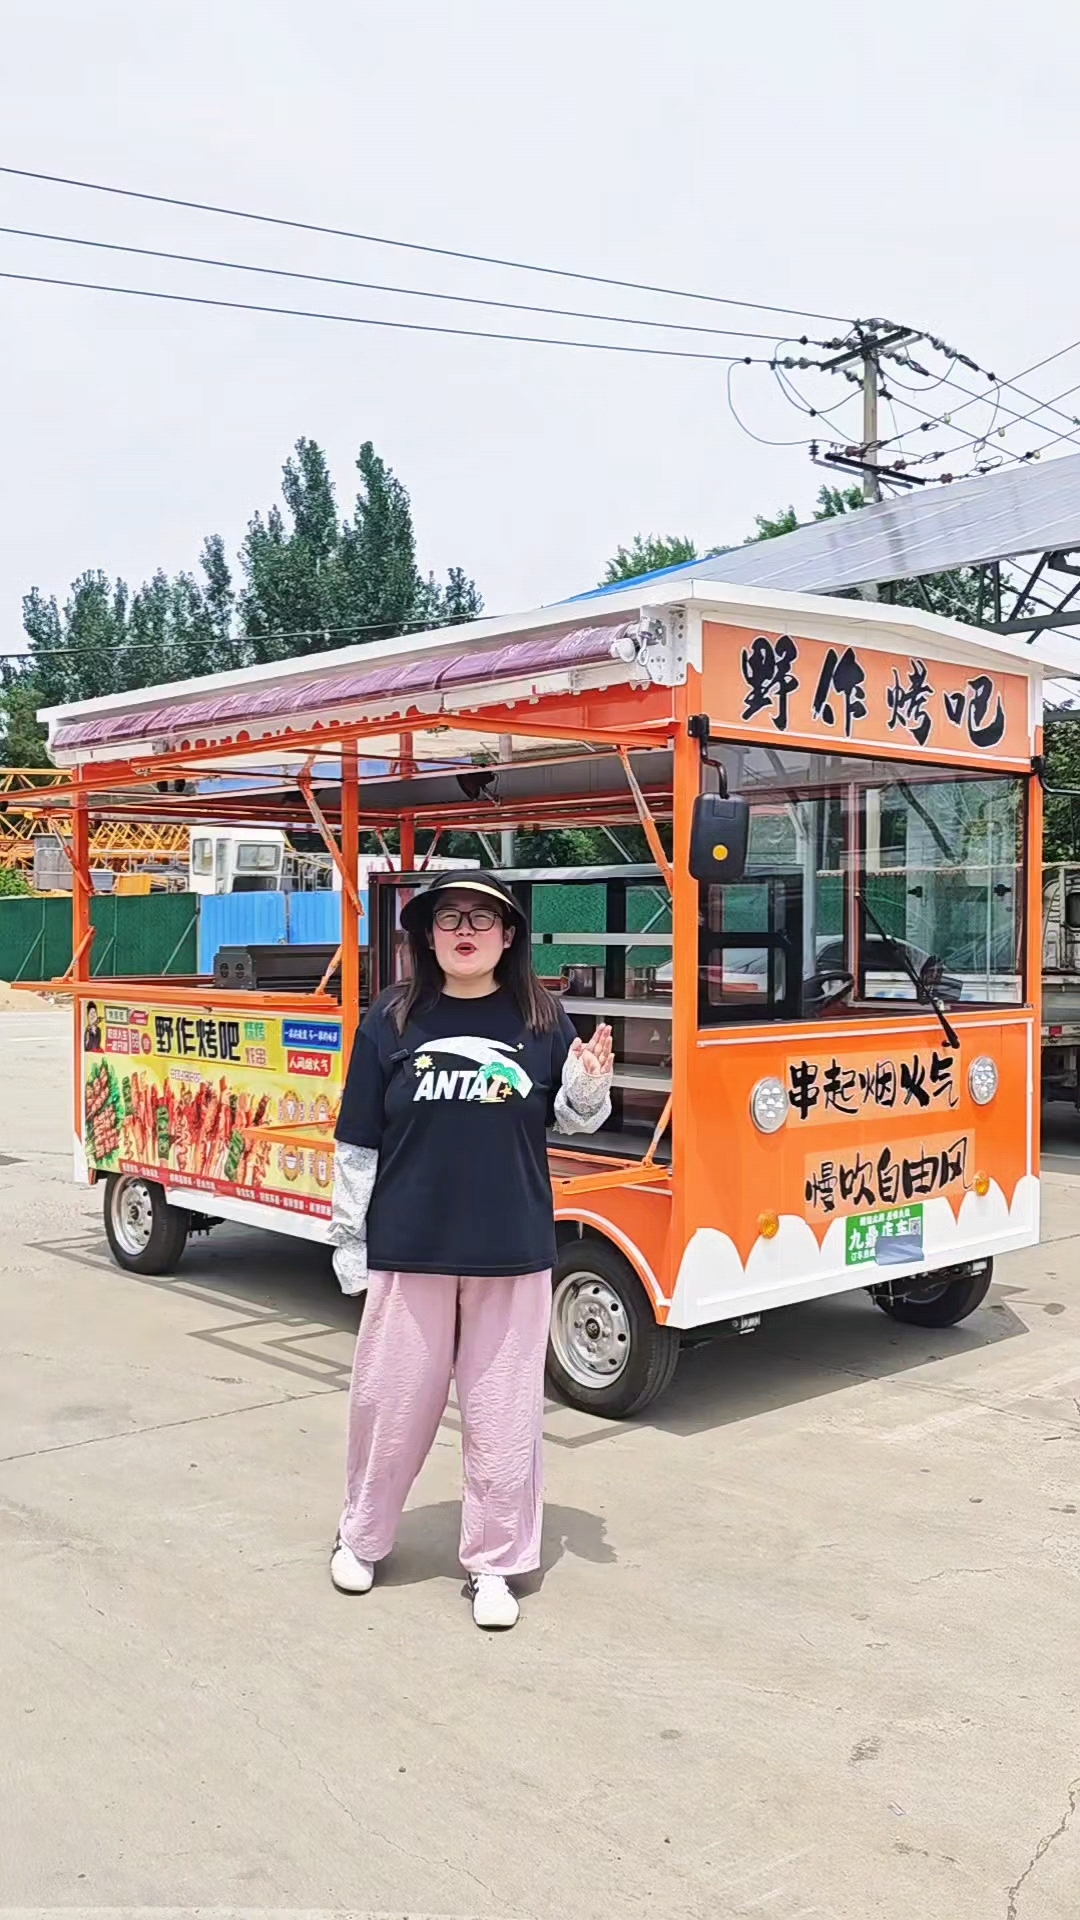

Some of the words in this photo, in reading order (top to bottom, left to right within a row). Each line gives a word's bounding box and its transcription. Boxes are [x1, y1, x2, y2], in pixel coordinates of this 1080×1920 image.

[741, 634, 1006, 748] 野作烤吧
[154, 1015, 240, 1061] 野作烤吧
[413, 1070, 490, 1102] ANTA
[789, 1052, 959, 1120] 串起烟火气
[805, 1137, 973, 1213] 慢吹自由风
